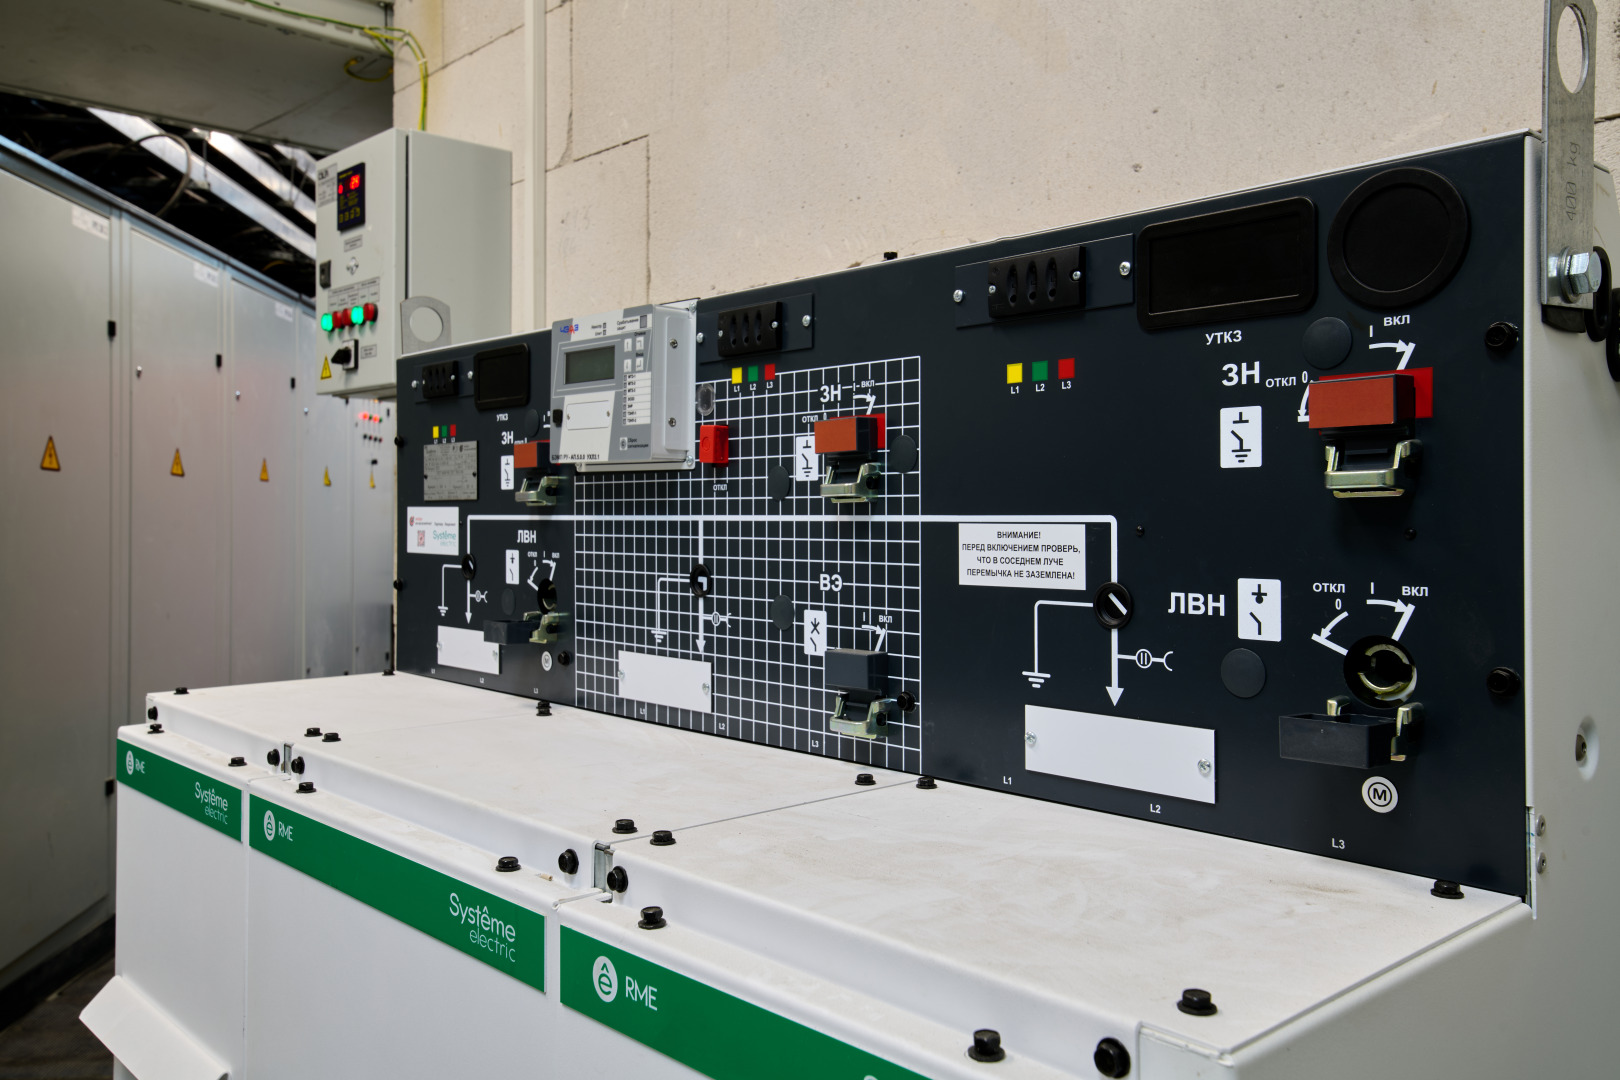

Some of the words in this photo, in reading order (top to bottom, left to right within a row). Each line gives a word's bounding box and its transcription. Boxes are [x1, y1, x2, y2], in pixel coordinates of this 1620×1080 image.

[1566, 142, 1580, 166] kg
[1566, 181, 1576, 220] 400
[1383, 314, 1410, 326] ВКЛ
[1206, 330, 1242, 346] УТКЗ
[1221, 360, 1260, 386] ЗН
[1035, 384, 1045, 392] L2
[1061, 381, 1072, 390] L3
[1265, 376, 1296, 388] ОТКЛ
[820, 384, 842, 403] ЗН
[1010, 386, 1020, 394] L1
[802, 415, 818, 423] ОТКЛ
[501, 431, 513, 445] ЗН
[516, 530, 536, 543] ЛВН
[962, 543, 985, 552] ПЕРЕД
[987, 544, 1039, 552] ВКЛЮЧЕНИЕМ
[1041, 544, 1080, 554] ПРОВЕРЬ,
[1000, 557, 1042, 565] СОСЕДНЕМ
[966, 568, 1012, 578] ПЕРЕМЫЧКА
[1025, 570, 1075, 580] ЗАЗЕМЛЕНА!
[819, 573, 842, 592] ВЭ
[1312, 582, 1346, 593] ОТКЛ
[1402, 585, 1429, 597] ВКЛ
[1168, 592, 1226, 616] ЛВН
[879, 615, 893, 624] ВКЛ
[135, 758, 145, 774] RME
[1003, 776, 1012, 785] L1
[195, 782, 228, 811] Systême
[1373, 789, 1386, 801] M
[1150, 804, 1161, 814] L2
[204, 806, 228, 825] electric
[278, 820, 293, 842] RME
[1332, 838, 1345, 849] L3
[449, 892, 516, 943] Systême
[470, 928, 516, 963] electric
[626, 976, 658, 1011] RME
